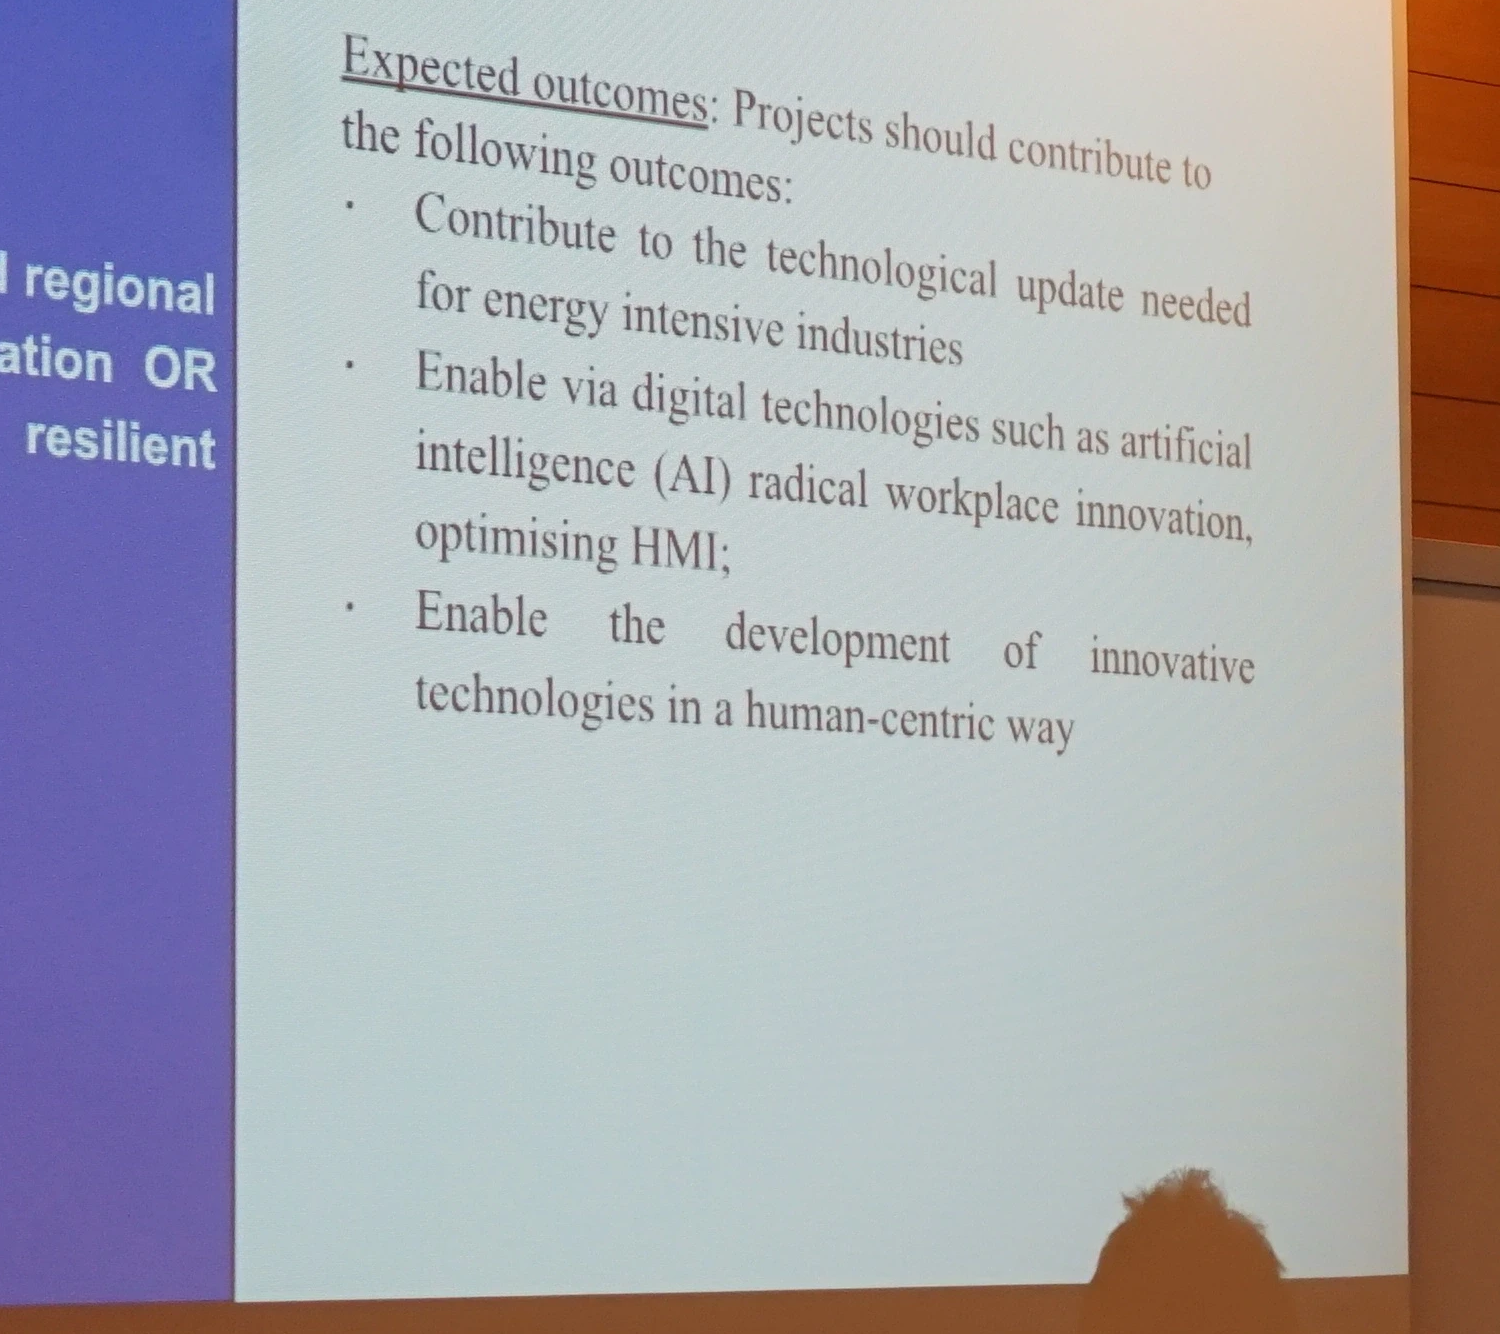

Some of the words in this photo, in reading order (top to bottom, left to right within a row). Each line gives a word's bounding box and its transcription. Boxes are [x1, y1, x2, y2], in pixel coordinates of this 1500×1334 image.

[342, 32, 522, 100] Expected
[532, 63, 719, 127] outcomes:
[735, 88, 873, 145] Projects
[886, 111, 996, 161] should
[1009, 140, 1171, 184] contribute
[1183, 159, 1211, 188] to
[342, 109, 400, 155] the
[416, 118, 596, 190] following
[610, 156, 791, 203] outcomes:
[26, 262, 213, 314] regional
[415, 193, 616, 253] Contribute
[640, 226, 673, 259] to
[694, 226, 746, 269] the
[767, 240, 996, 301] technological
[1018, 270, 1124, 314] update
[1143, 288, 1251, 327] needed
[418, 269, 471, 313] for
[484, 290, 607, 339] energy
[624, 296, 784, 347] intensive
[798, 316, 963, 364] industries
[145, 345, 215, 391] OR
[418, 349, 546, 401] Enable
[563, 366, 617, 407] via
[632, 372, 745, 426] digital
[762, 389, 979, 448] technologies
[993, 413, 1064, 451] such
[1077, 429, 1109, 453] as
[1121, 426, 1250, 469] artificial
[27, 419, 215, 469] resilient
[417, 429, 635, 492] intelligence
[654, 455, 731, 499] (AI)
[750, 463, 867, 508] radical
[886, 477, 1058, 528] workplace
[1077, 495, 1252, 543] innovation,
[415, 511, 617, 575] optimising
[634, 526, 730, 575] HMI;
[417, 589, 547, 638] Enable
[610, 603, 665, 645] the
[725, 610, 949, 668] development
[1004, 631, 1042, 670] of
[1092, 635, 1255, 685] innovative
[416, 672, 655, 732] technologies
[669, 683, 701, 725] in
[715, 700, 733, 726] a
[747, 689, 994, 742] human-centric
[1008, 717, 1073, 756] way
